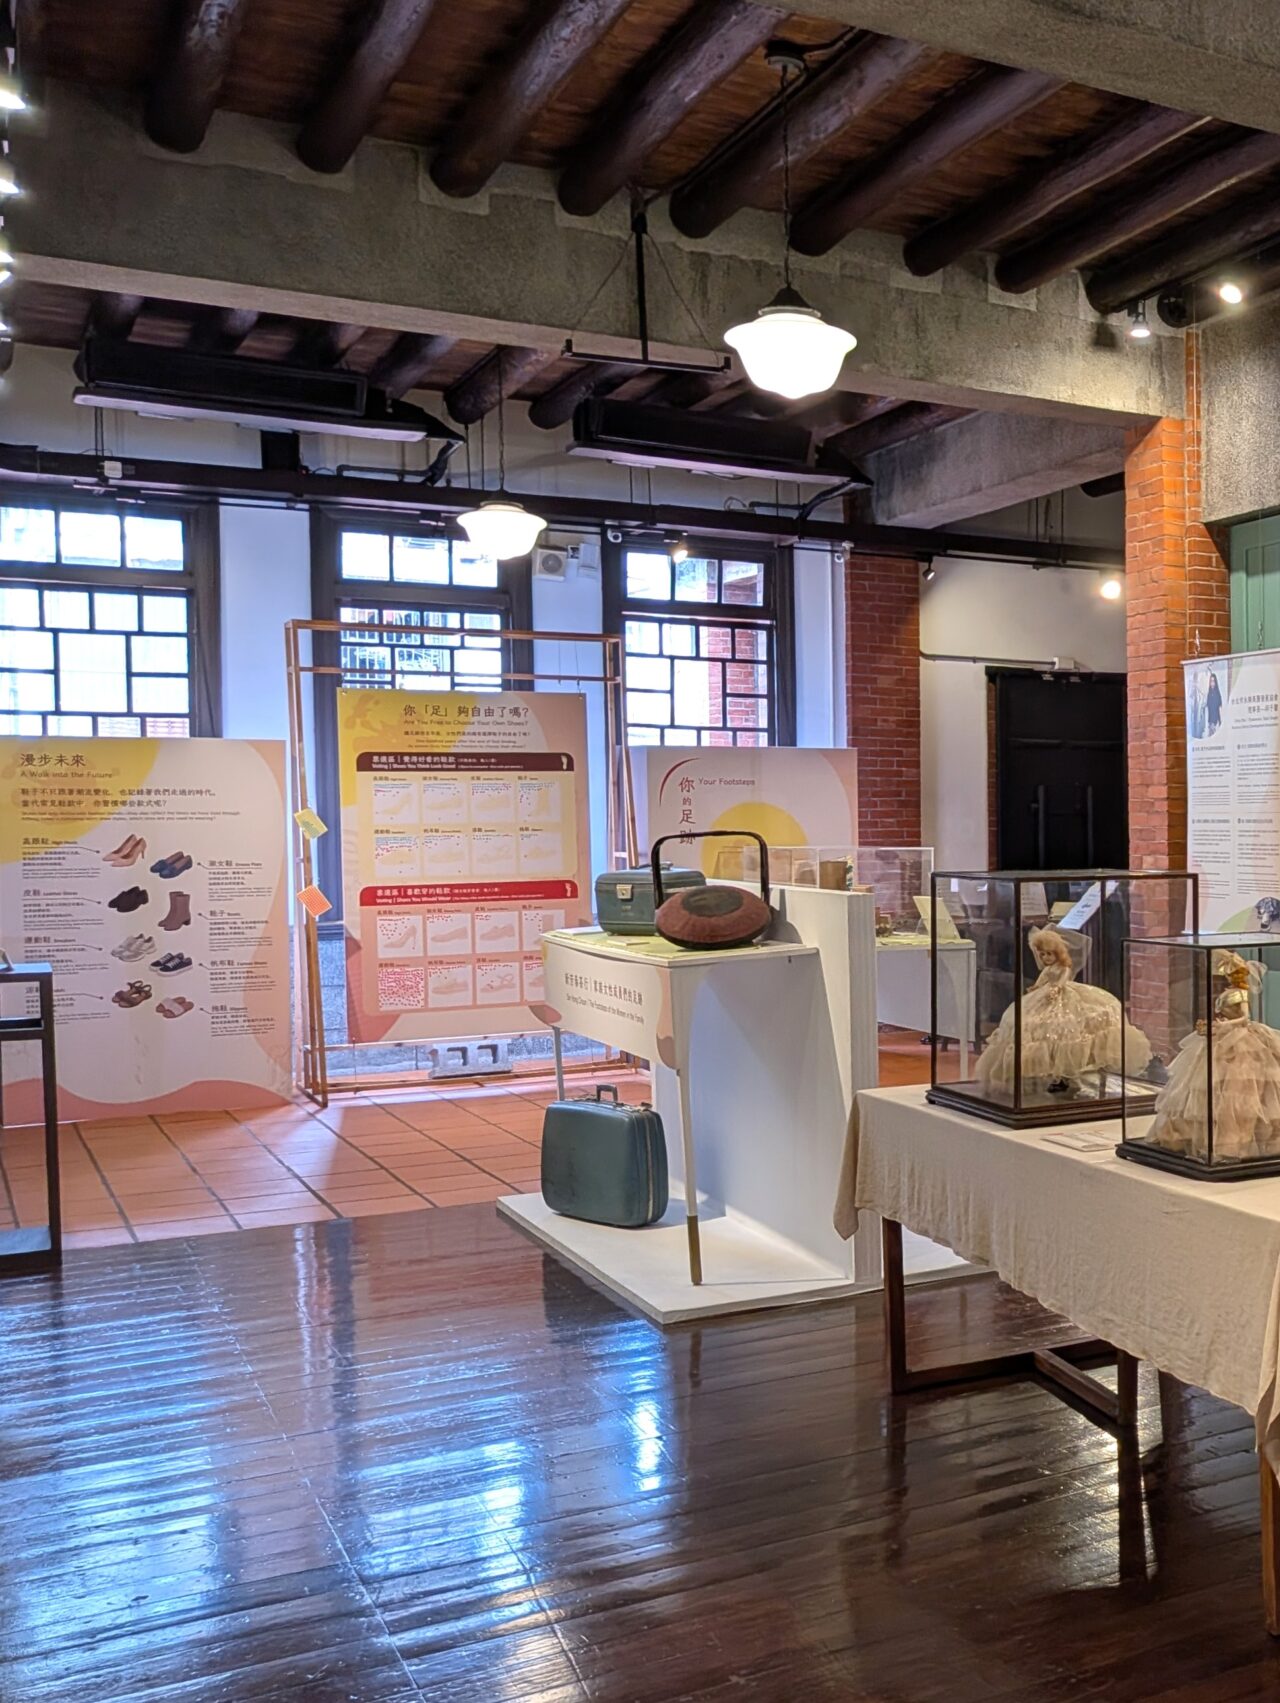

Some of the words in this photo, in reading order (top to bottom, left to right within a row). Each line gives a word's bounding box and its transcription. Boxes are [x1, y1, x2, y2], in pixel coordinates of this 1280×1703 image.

[20, 753, 87, 767] 漫步未來
[698, 777, 717, 786] Your
[718, 777, 755, 786] Footsteps
